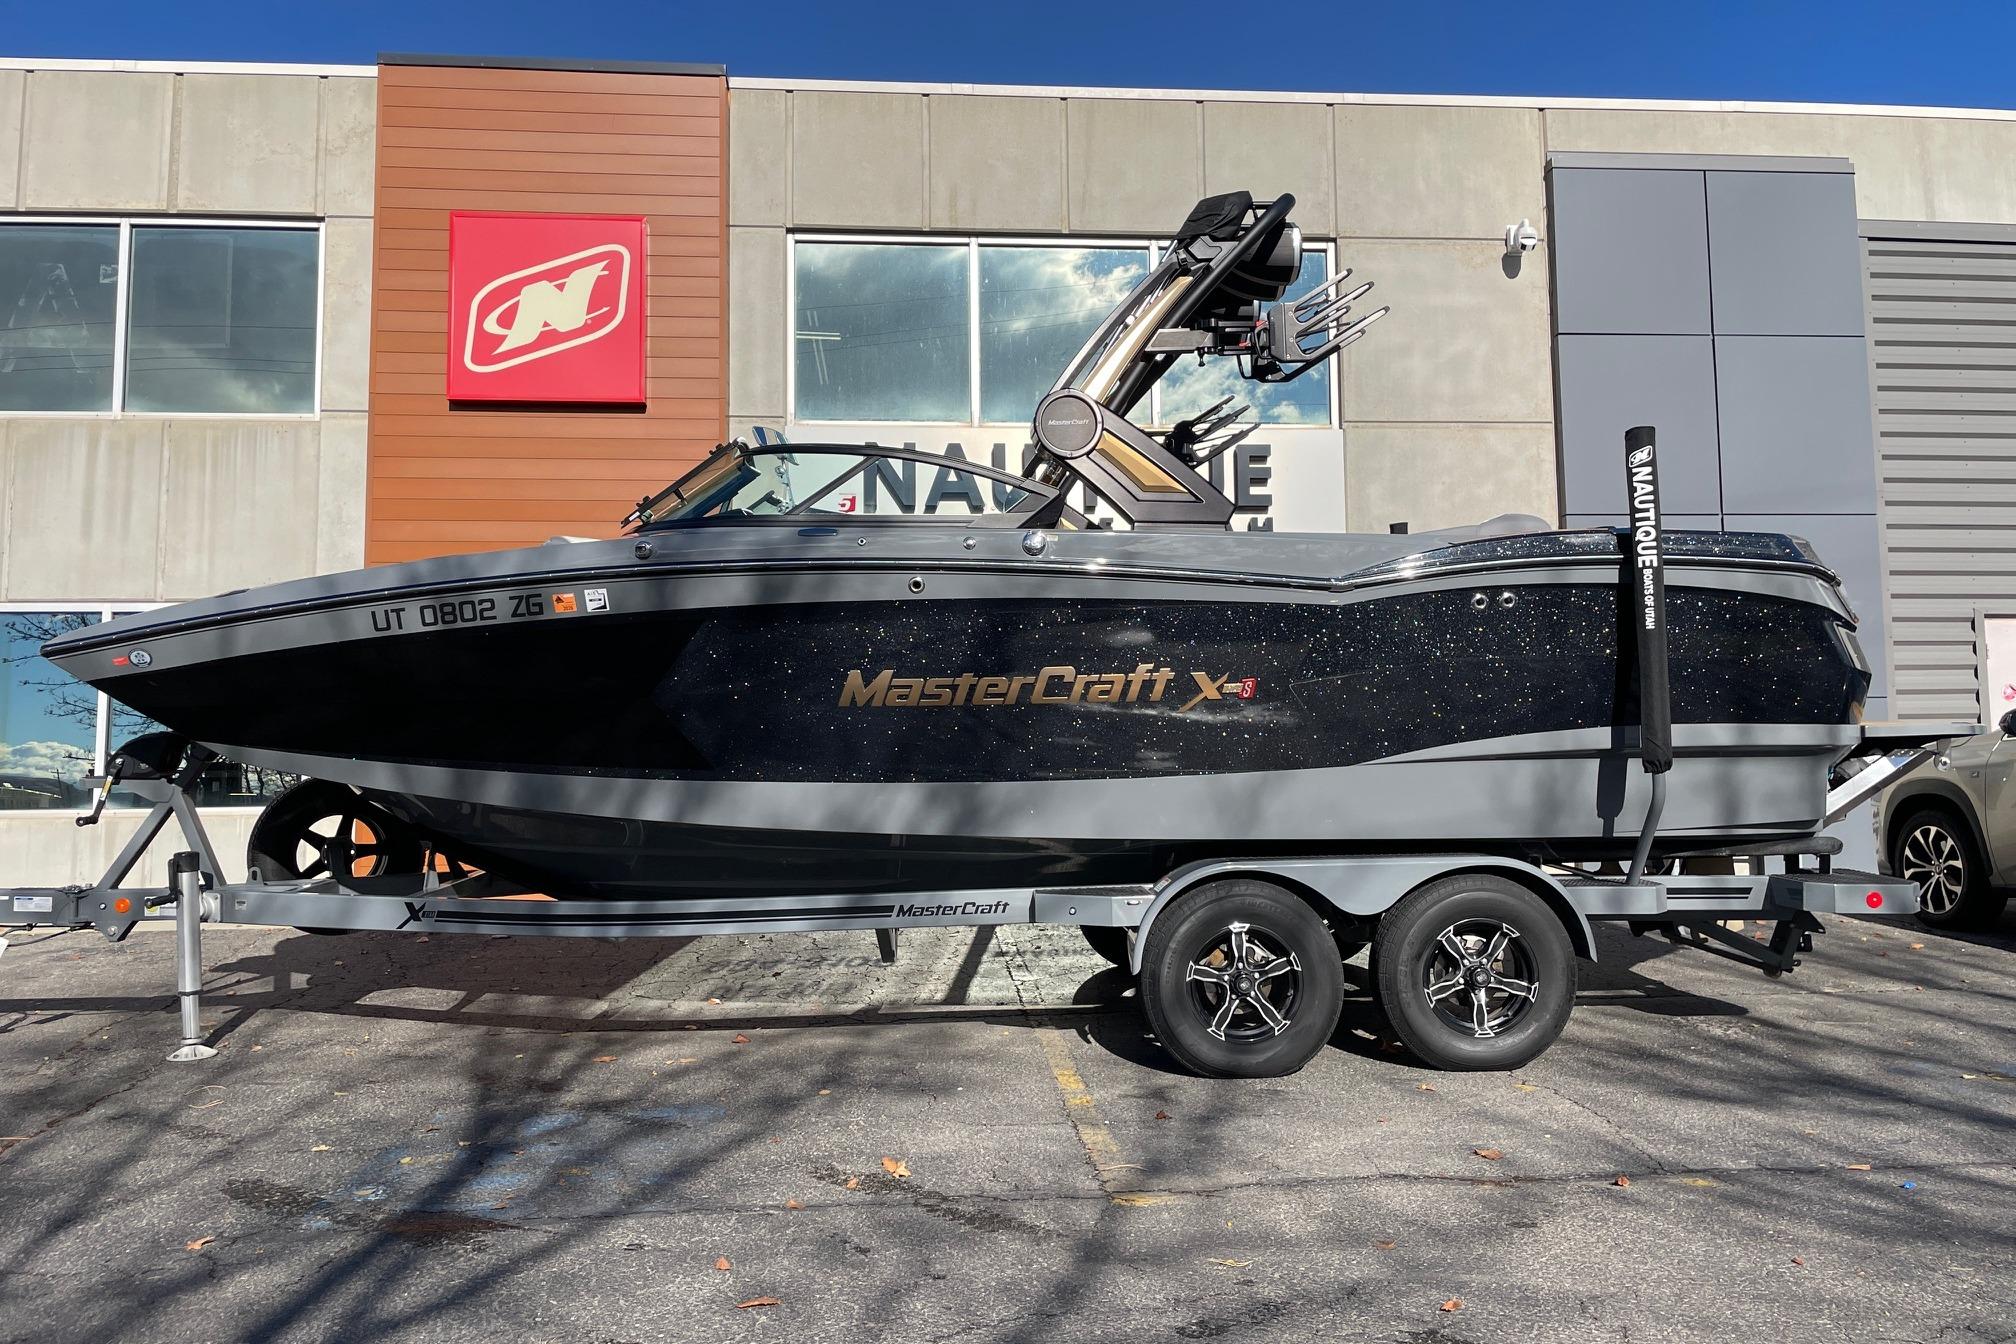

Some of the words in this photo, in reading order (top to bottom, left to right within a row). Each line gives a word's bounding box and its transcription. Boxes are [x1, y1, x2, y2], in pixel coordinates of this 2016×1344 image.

[1631, 466, 1659, 568] NAUTIQUE
[1642, 568, 1654, 595] BOATS
[370, 607, 406, 632] UT
[419, 598, 498, 627] 0802
[508, 593, 545, 618] ZG
[1644, 595, 1655, 607] OF
[1644, 607, 1656, 630] UTAH
[838, 662, 1176, 707] MasterCraft
[896, 900, 1010, 918] MasterCraft
